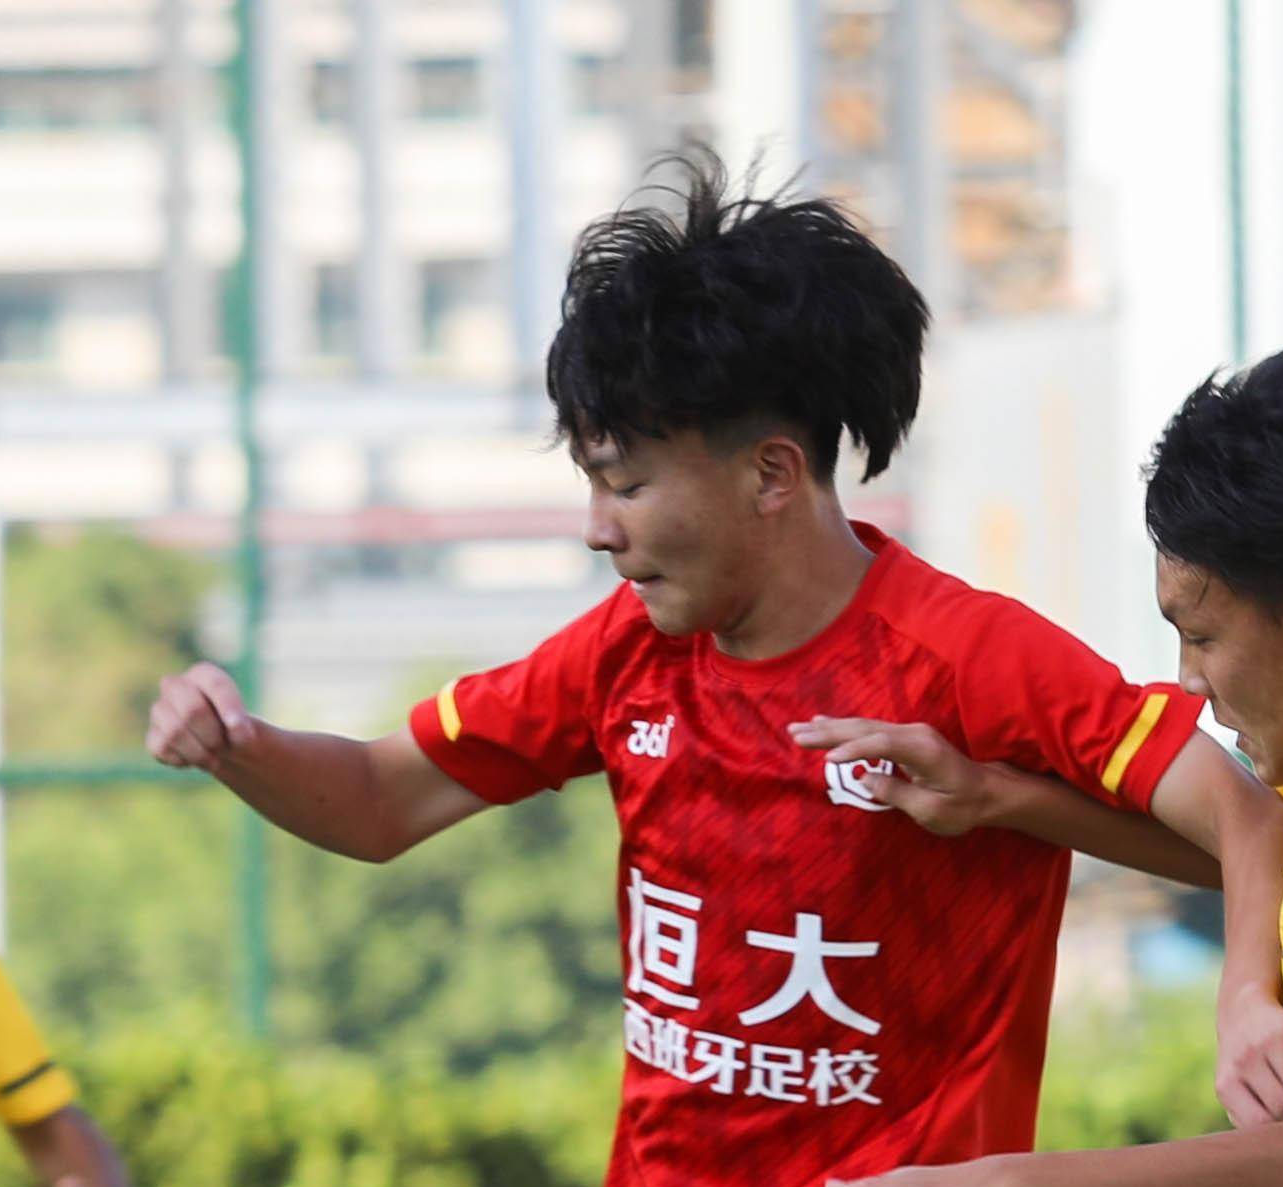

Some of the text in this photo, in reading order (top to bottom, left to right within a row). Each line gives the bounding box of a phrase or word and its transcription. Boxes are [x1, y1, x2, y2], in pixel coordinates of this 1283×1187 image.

[627, 867, 882, 1036] 恒大
[622, 997, 882, 1106] 西班牙足校
